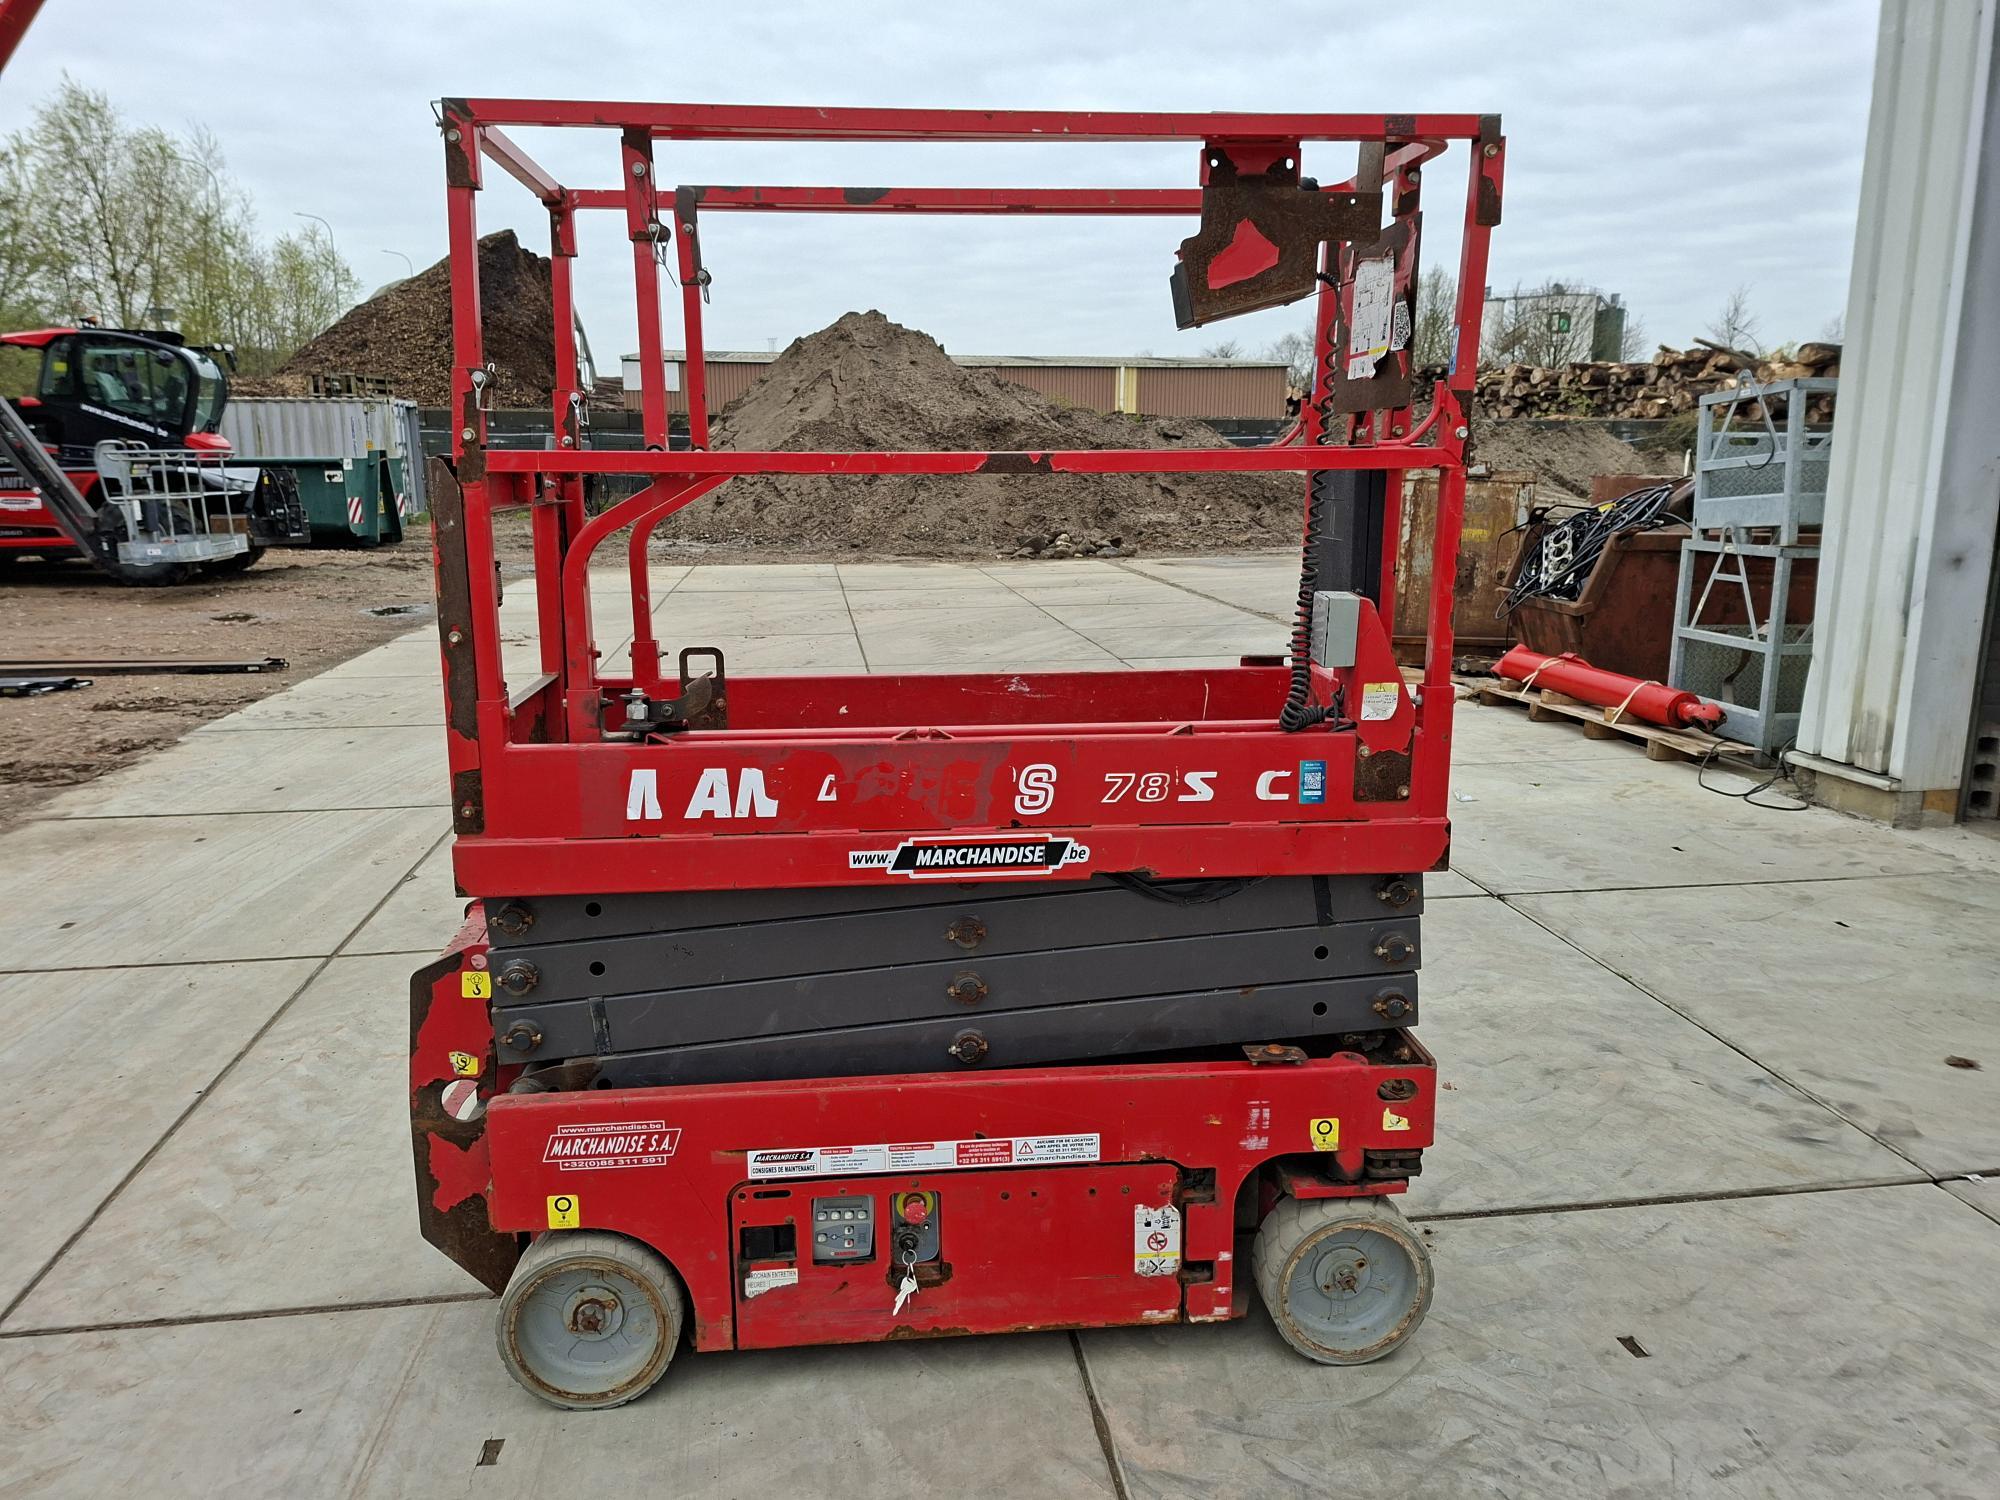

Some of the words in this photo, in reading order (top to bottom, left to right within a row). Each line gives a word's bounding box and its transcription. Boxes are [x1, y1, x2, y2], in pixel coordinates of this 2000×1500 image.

[1101, 773, 1170, 803] 78
[852, 853, 892, 866] www.
[916, 846, 1046, 867] MARCHANDISE
[561, 1123, 662, 1133] www.marchandise.be
[551, 1135, 646, 1157] MARCHANDISE
[648, 1134, 673, 1151] S.A.
[756, 1153, 799, 1162] MARCHANDISE
[1017, 1153, 1097, 1162] www.marchandise.be
[563, 1160, 615, 1168] +32(0)85
[617, 1158, 638, 1166] 311
[752, 1166, 778, 1174] CONSIGNES
[784, 1165, 816, 1173] MAINTENANCE
[771, 1270, 797, 1278] ENTRETIEN
